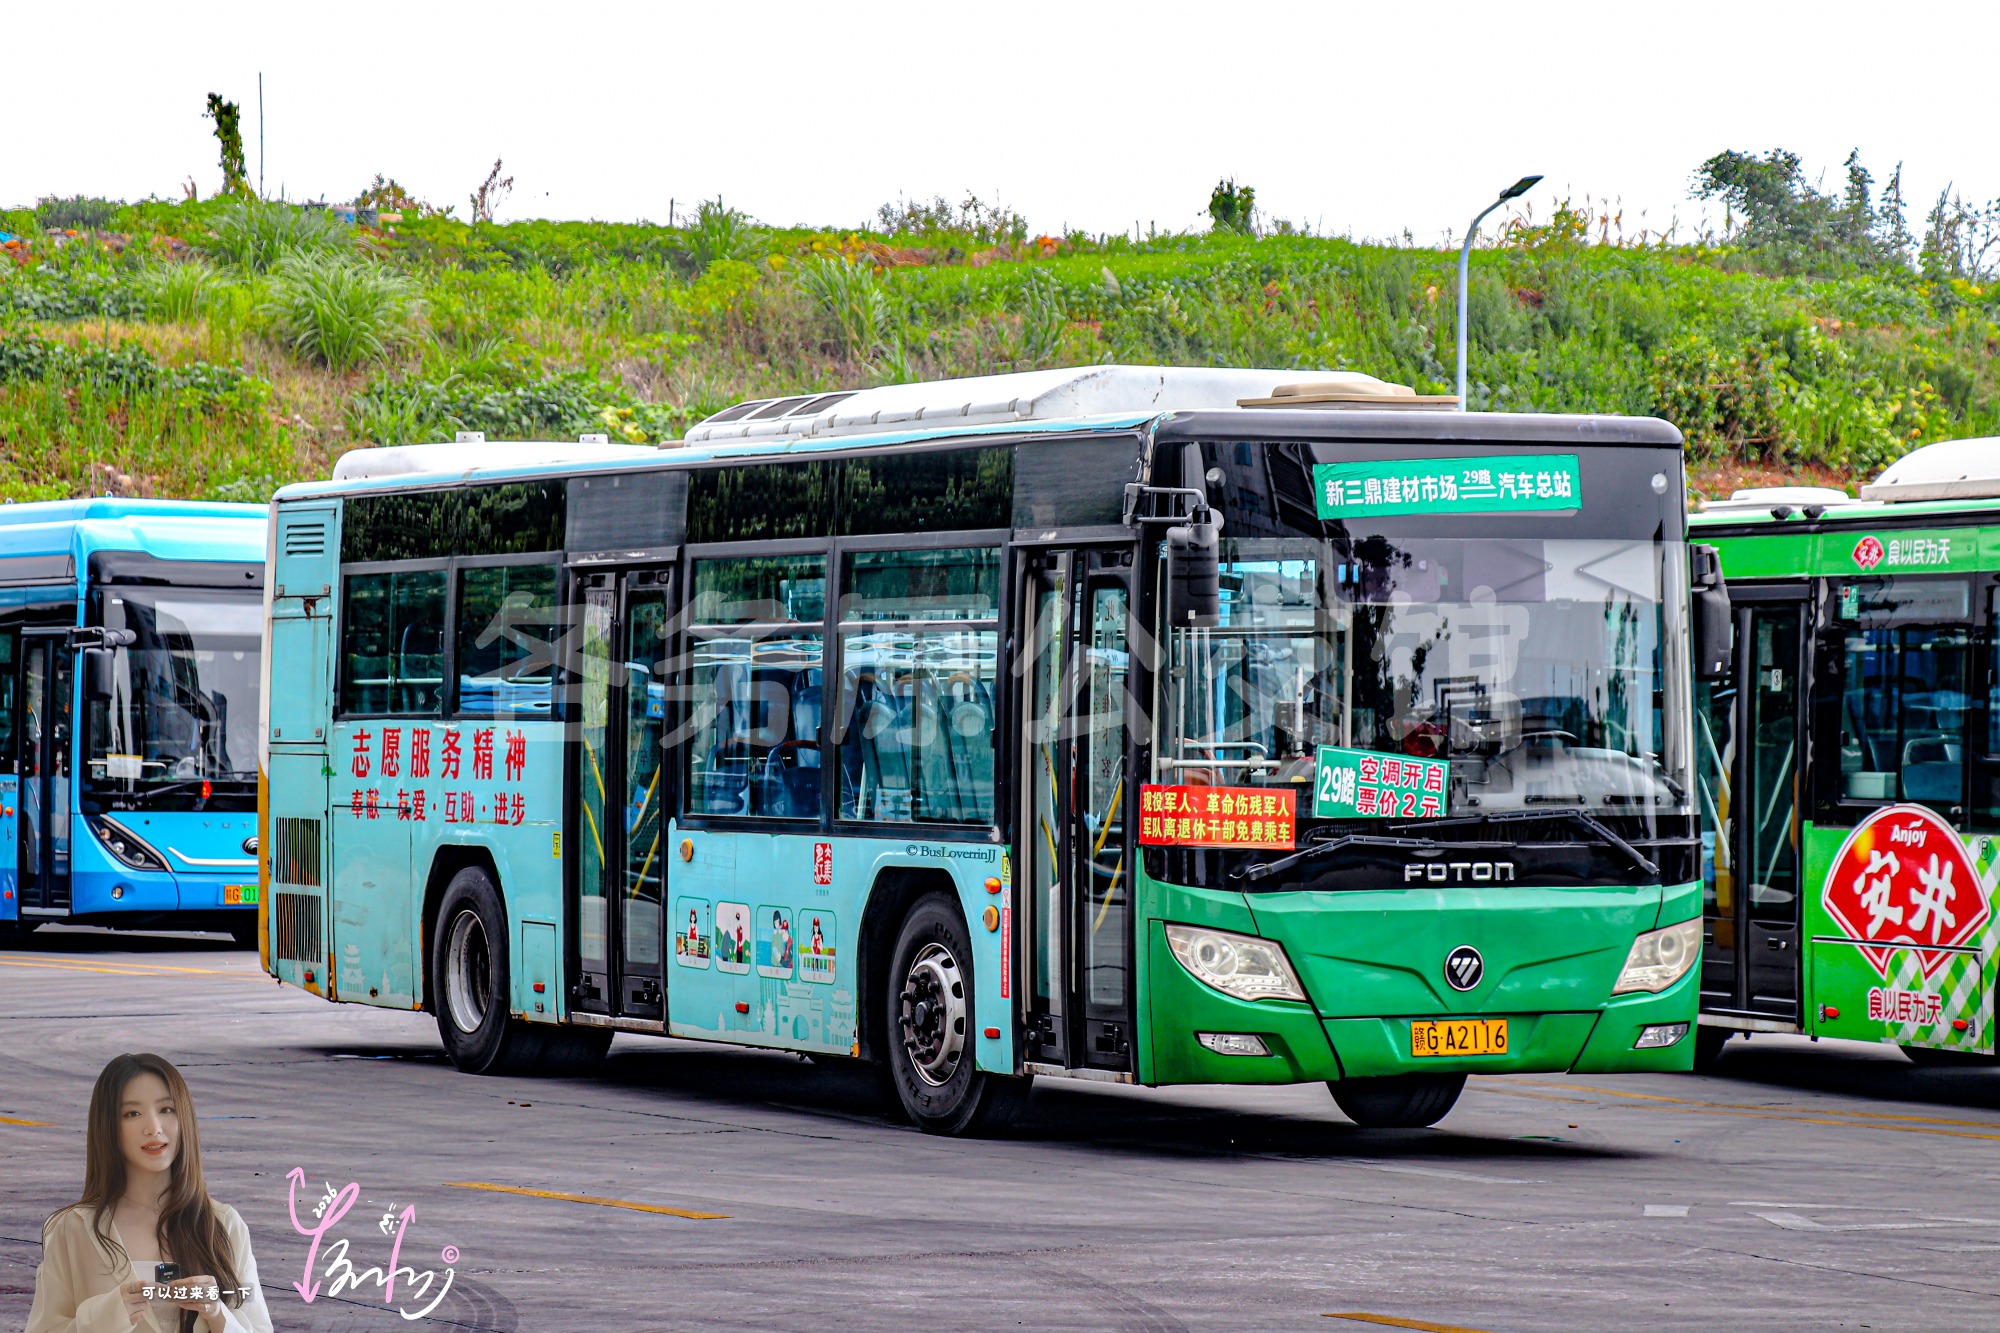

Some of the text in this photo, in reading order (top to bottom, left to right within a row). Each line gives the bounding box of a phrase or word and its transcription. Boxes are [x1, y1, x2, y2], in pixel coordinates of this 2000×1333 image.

[1325, 469, 1572, 506] 新三鼎建材市场 29路 汽车总站
[1888, 539, 1950, 565] 食以民为天
[351, 727, 526, 781] 志愿服务精神
[1320, 766, 1356, 805] 29路
[1359, 757, 1444, 792] 空调开启
[1143, 791, 1290, 817] 现役军人、革命伤残军人
[1356, 787, 1440, 818] 票价2元
[1143, 817, 1291, 843] 军队离退休干部免费乘车
[1890, 823, 1928, 847] Anjoy
[1404, 862, 1515, 882] FOTON
[1853, 850, 1956, 945] 安井
[1869, 987, 1942, 1025] 食以民为天
